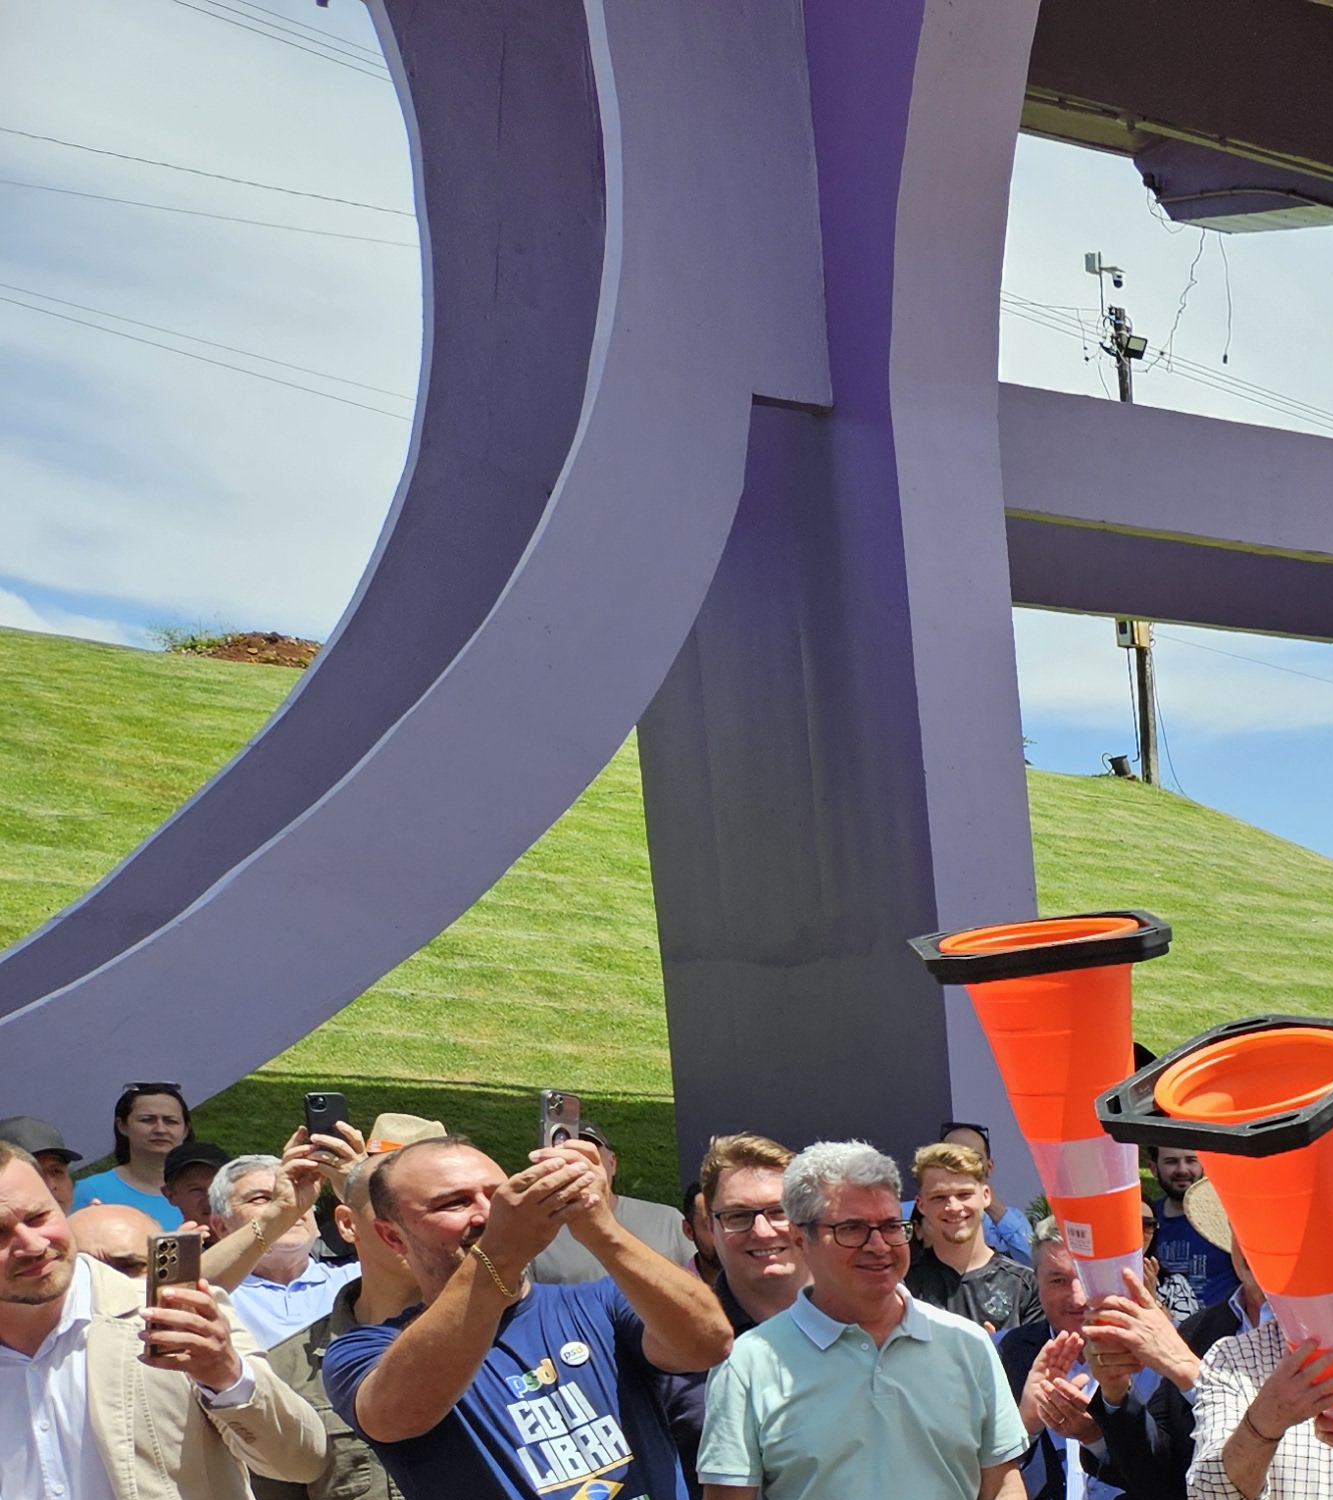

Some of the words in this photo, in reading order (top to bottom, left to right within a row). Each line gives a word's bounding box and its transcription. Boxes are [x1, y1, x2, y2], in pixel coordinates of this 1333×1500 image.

[506, 1357, 557, 1398] psd
[563, 1346, 583, 1360] psd
[507, 1381, 598, 1444] EQUI
[517, 1415, 632, 1488] LIBRA
